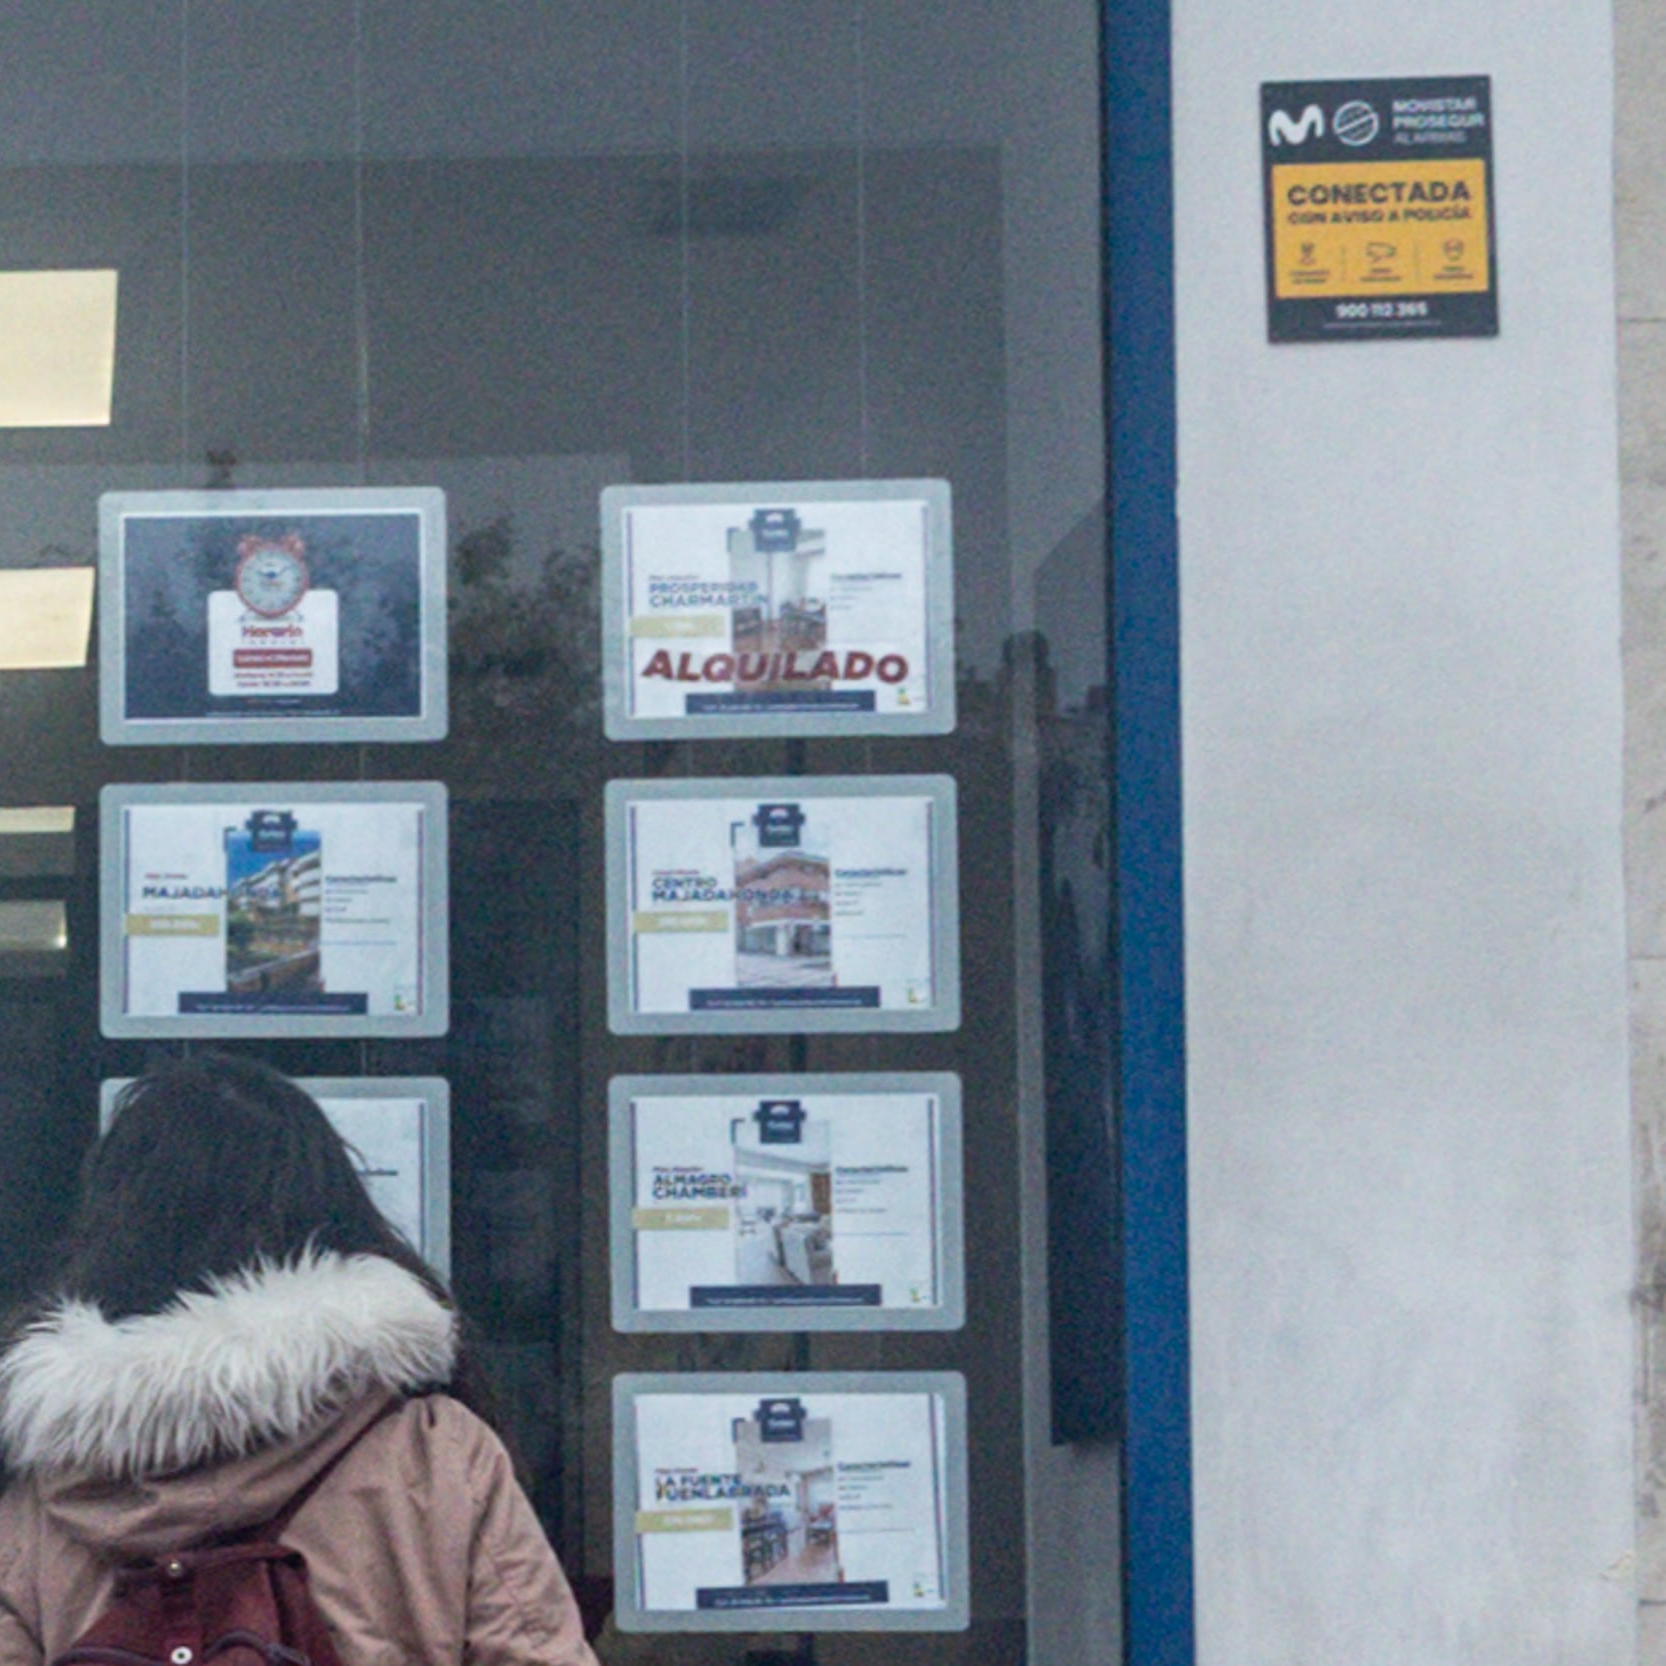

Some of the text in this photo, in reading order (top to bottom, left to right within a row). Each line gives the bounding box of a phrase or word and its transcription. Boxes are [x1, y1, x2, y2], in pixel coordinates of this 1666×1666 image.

[1393, 97, 1476, 112] MOVISTAR
[1393, 114, 1485, 128] PROSEGUR
[1287, 181, 1471, 205] CONECTADA
[1287, 206, 1471, 225] CON AVISO A POLICÍA
[1335, 303, 1369, 318] 900
[641, 649, 909, 685] ALQUILADO
[652, 877, 717, 888] CENTRO
[652, 889, 792, 902] MAJADAHONDA
[653, 1174, 731, 1186] ALMAGRO
[681, 1474, 742, 1486] FUENTE
